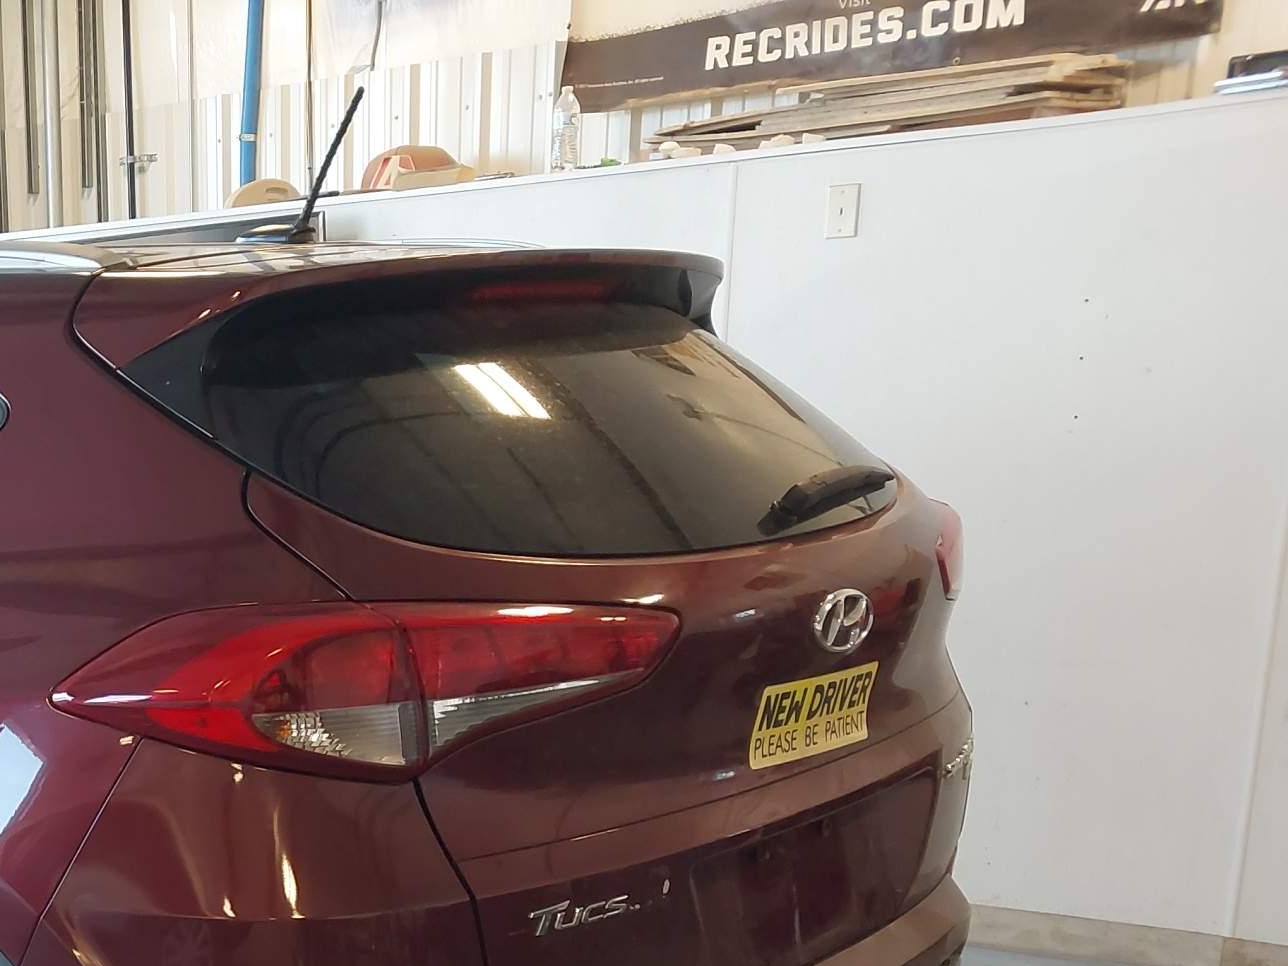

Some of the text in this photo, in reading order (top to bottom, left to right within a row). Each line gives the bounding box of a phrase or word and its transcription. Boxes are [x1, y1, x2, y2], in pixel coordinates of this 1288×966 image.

[704, 0, 1025, 71] RECRIDES.COM
[758, 670, 873, 732] NEW DRIVER
[753, 710, 865, 760] PLEASE BE PATIENT
